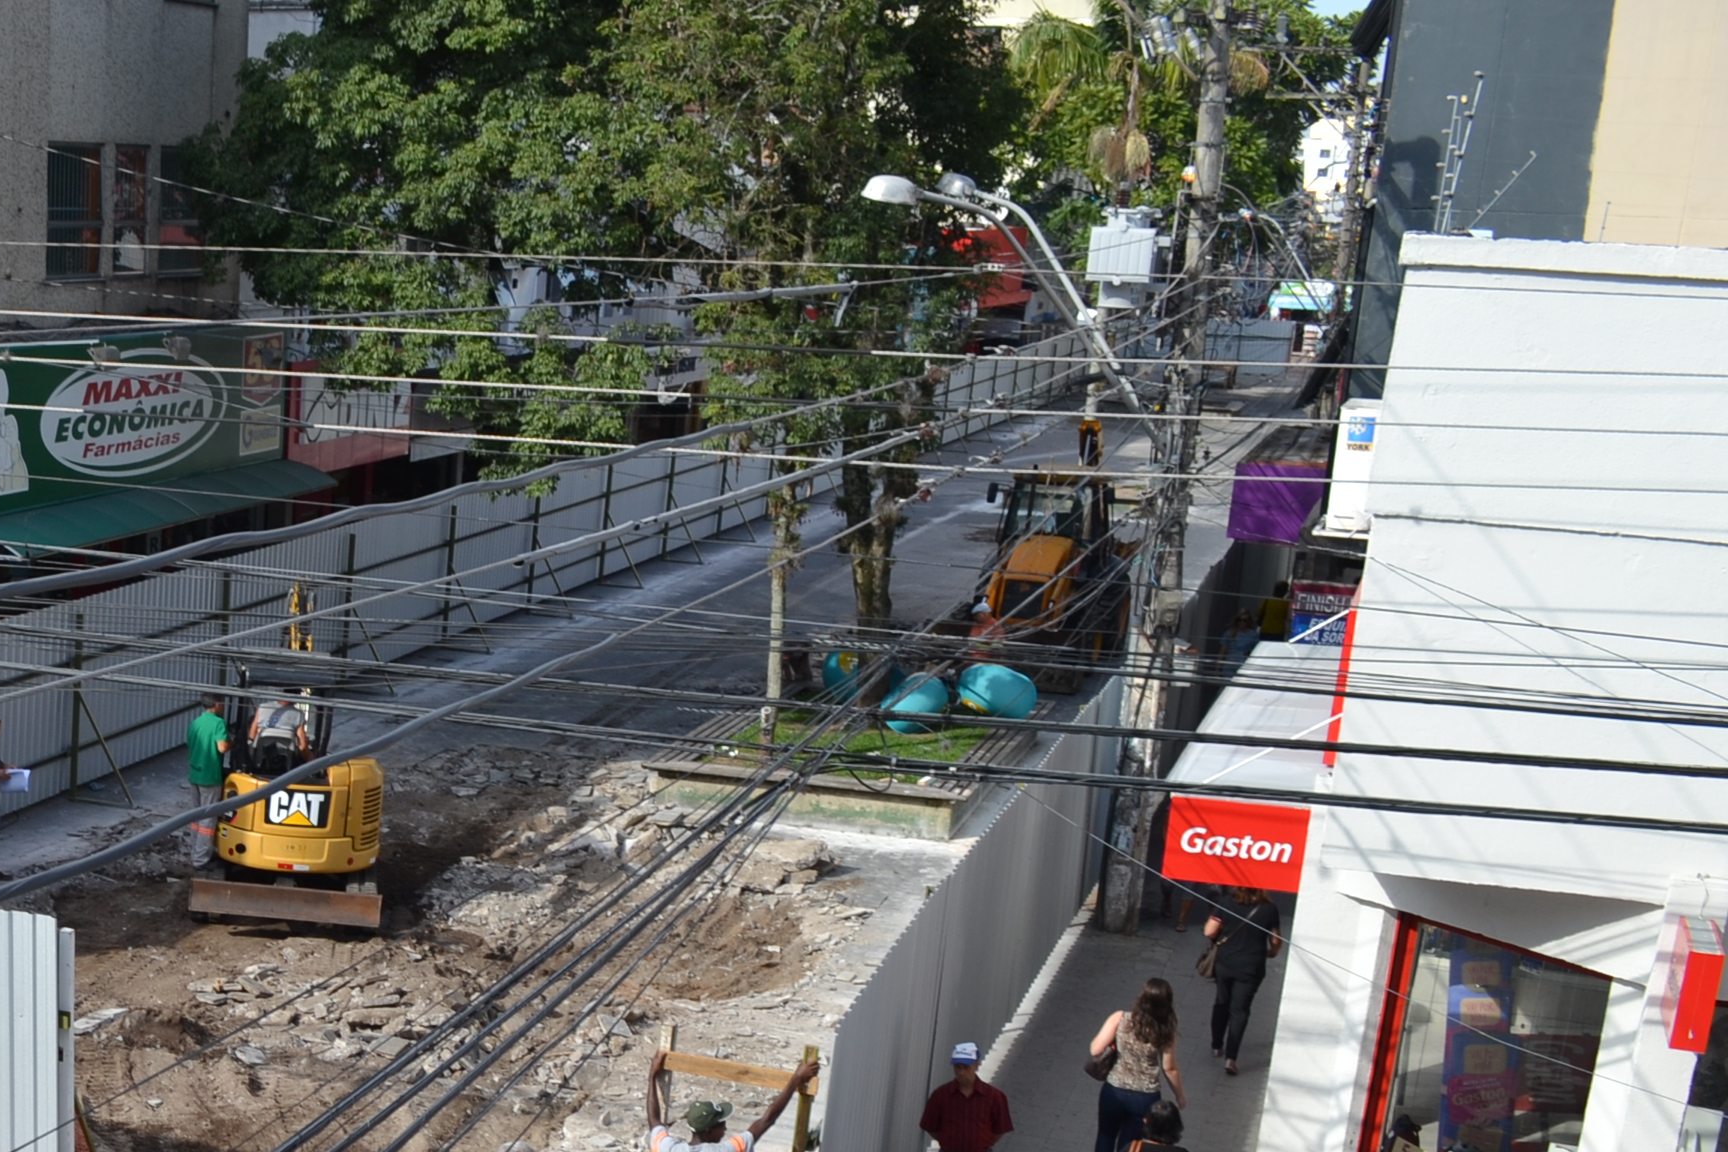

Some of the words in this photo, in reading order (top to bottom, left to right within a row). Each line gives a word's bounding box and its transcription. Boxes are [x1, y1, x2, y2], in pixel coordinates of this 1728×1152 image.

[82, 371, 183, 406] MAXXI
[54, 399, 204, 443] ECONÔMICA
[82, 431, 181, 459] Farmácias
[1347, 443, 1371, 452] YORK
[269, 789, 326, 827] CAT
[1180, 826, 1293, 864] Gaston
[1452, 1087, 1506, 1106] Gaston
